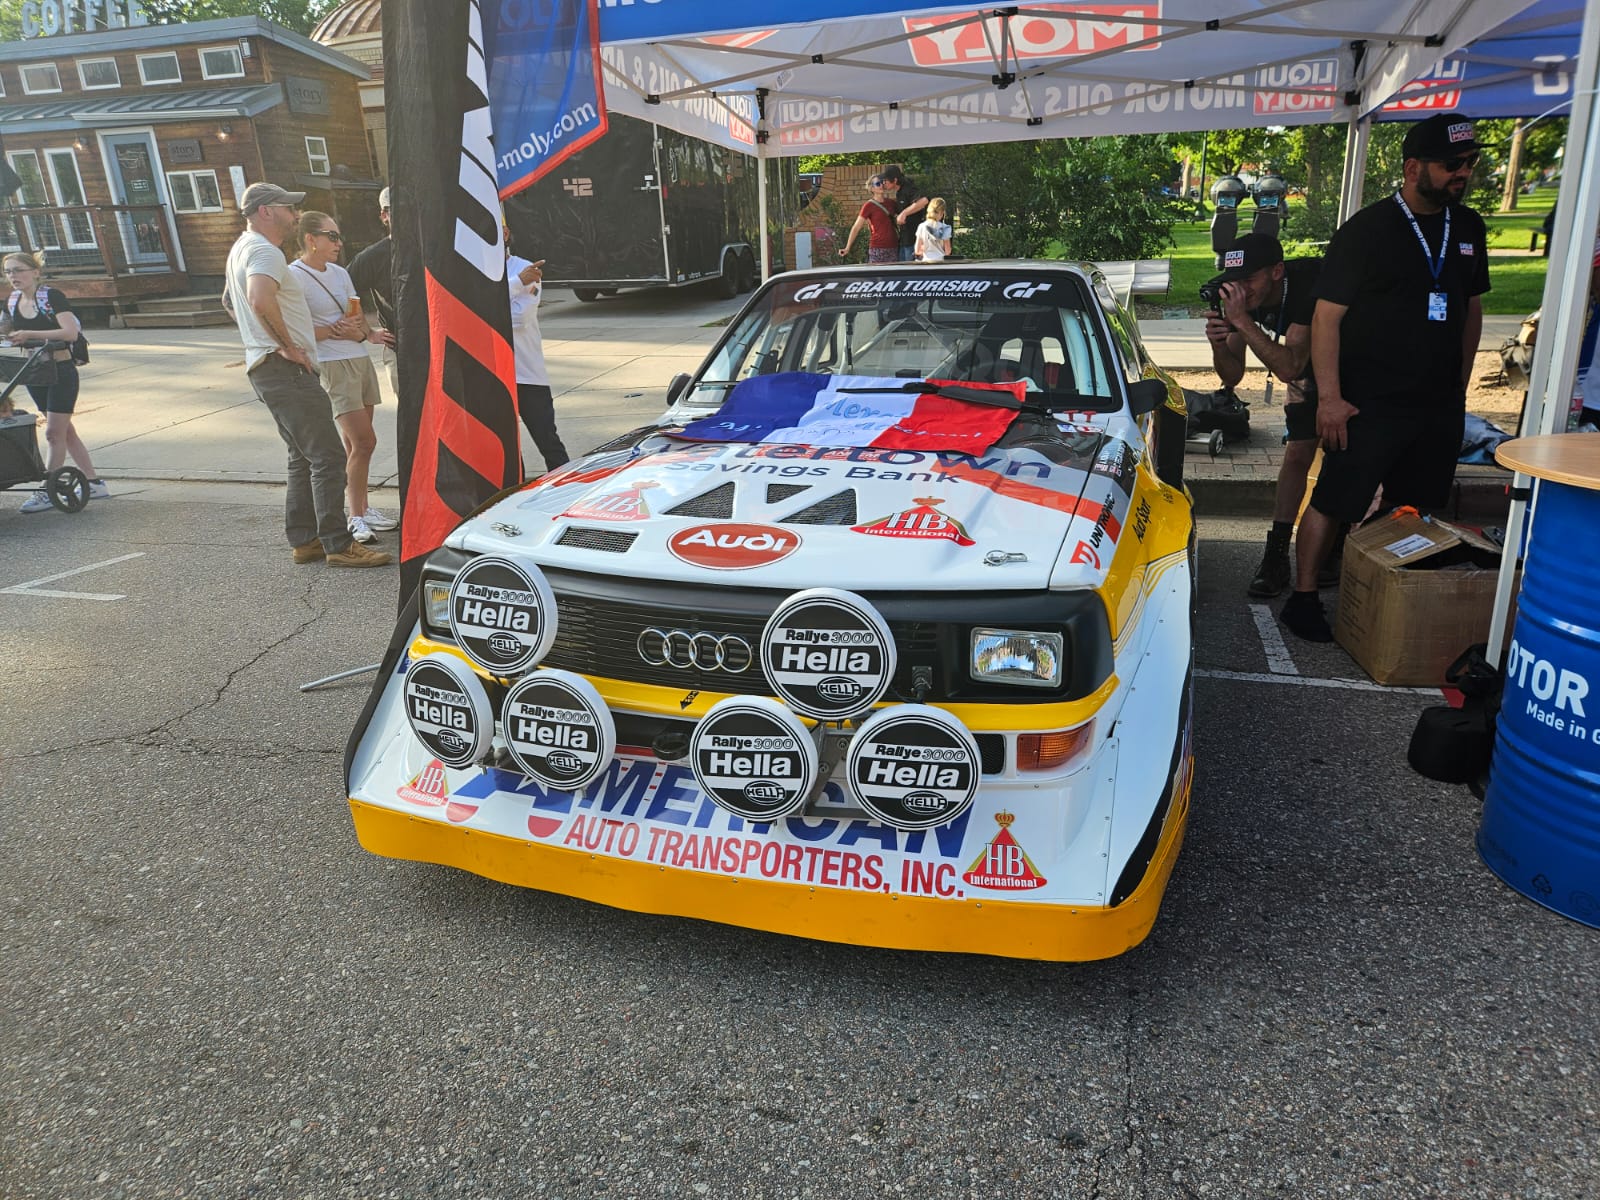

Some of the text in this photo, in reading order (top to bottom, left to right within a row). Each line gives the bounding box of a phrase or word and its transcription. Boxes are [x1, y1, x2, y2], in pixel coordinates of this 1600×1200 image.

[563, 178, 593, 196] 42
[844, 281, 896, 293] GRAN
[664, 461, 963, 483] Savings Bank
[885, 512, 948, 530] HB
[682, 529, 788, 552] Audi
[466, 585, 534, 605] Rallye 3000
[461, 601, 531, 632] Hella
[489, 638, 522, 653] HELLA
[785, 629, 874, 644] Rallye 3000
[781, 646, 871, 673] Hella
[415, 684, 467, 706] Rallye 3000
[820, 682, 862, 697] HELLA
[415, 696, 467, 730] Hella
[520, 704, 591, 724] Rallye 3000
[1526, 700, 1564, 731] Made
[1569, 720, 1586, 740] in
[439, 734, 465, 750] HELLA
[517, 719, 589, 750] Hella
[711, 736, 793, 750] Rallye 3000
[548, 756, 583, 770] HELLA
[875, 745, 966, 762] Rallye 3000
[709, 752, 792, 777] Hella
[415, 766, 445, 795] HB
[867, 762, 960, 788] Hella
[746, 786, 785, 799] HELLA
[903, 794, 948, 809] HELLA
[564, 814, 964, 898] AUTO TRANSPORTERS, INC.
[985, 842, 1026, 877] HB
